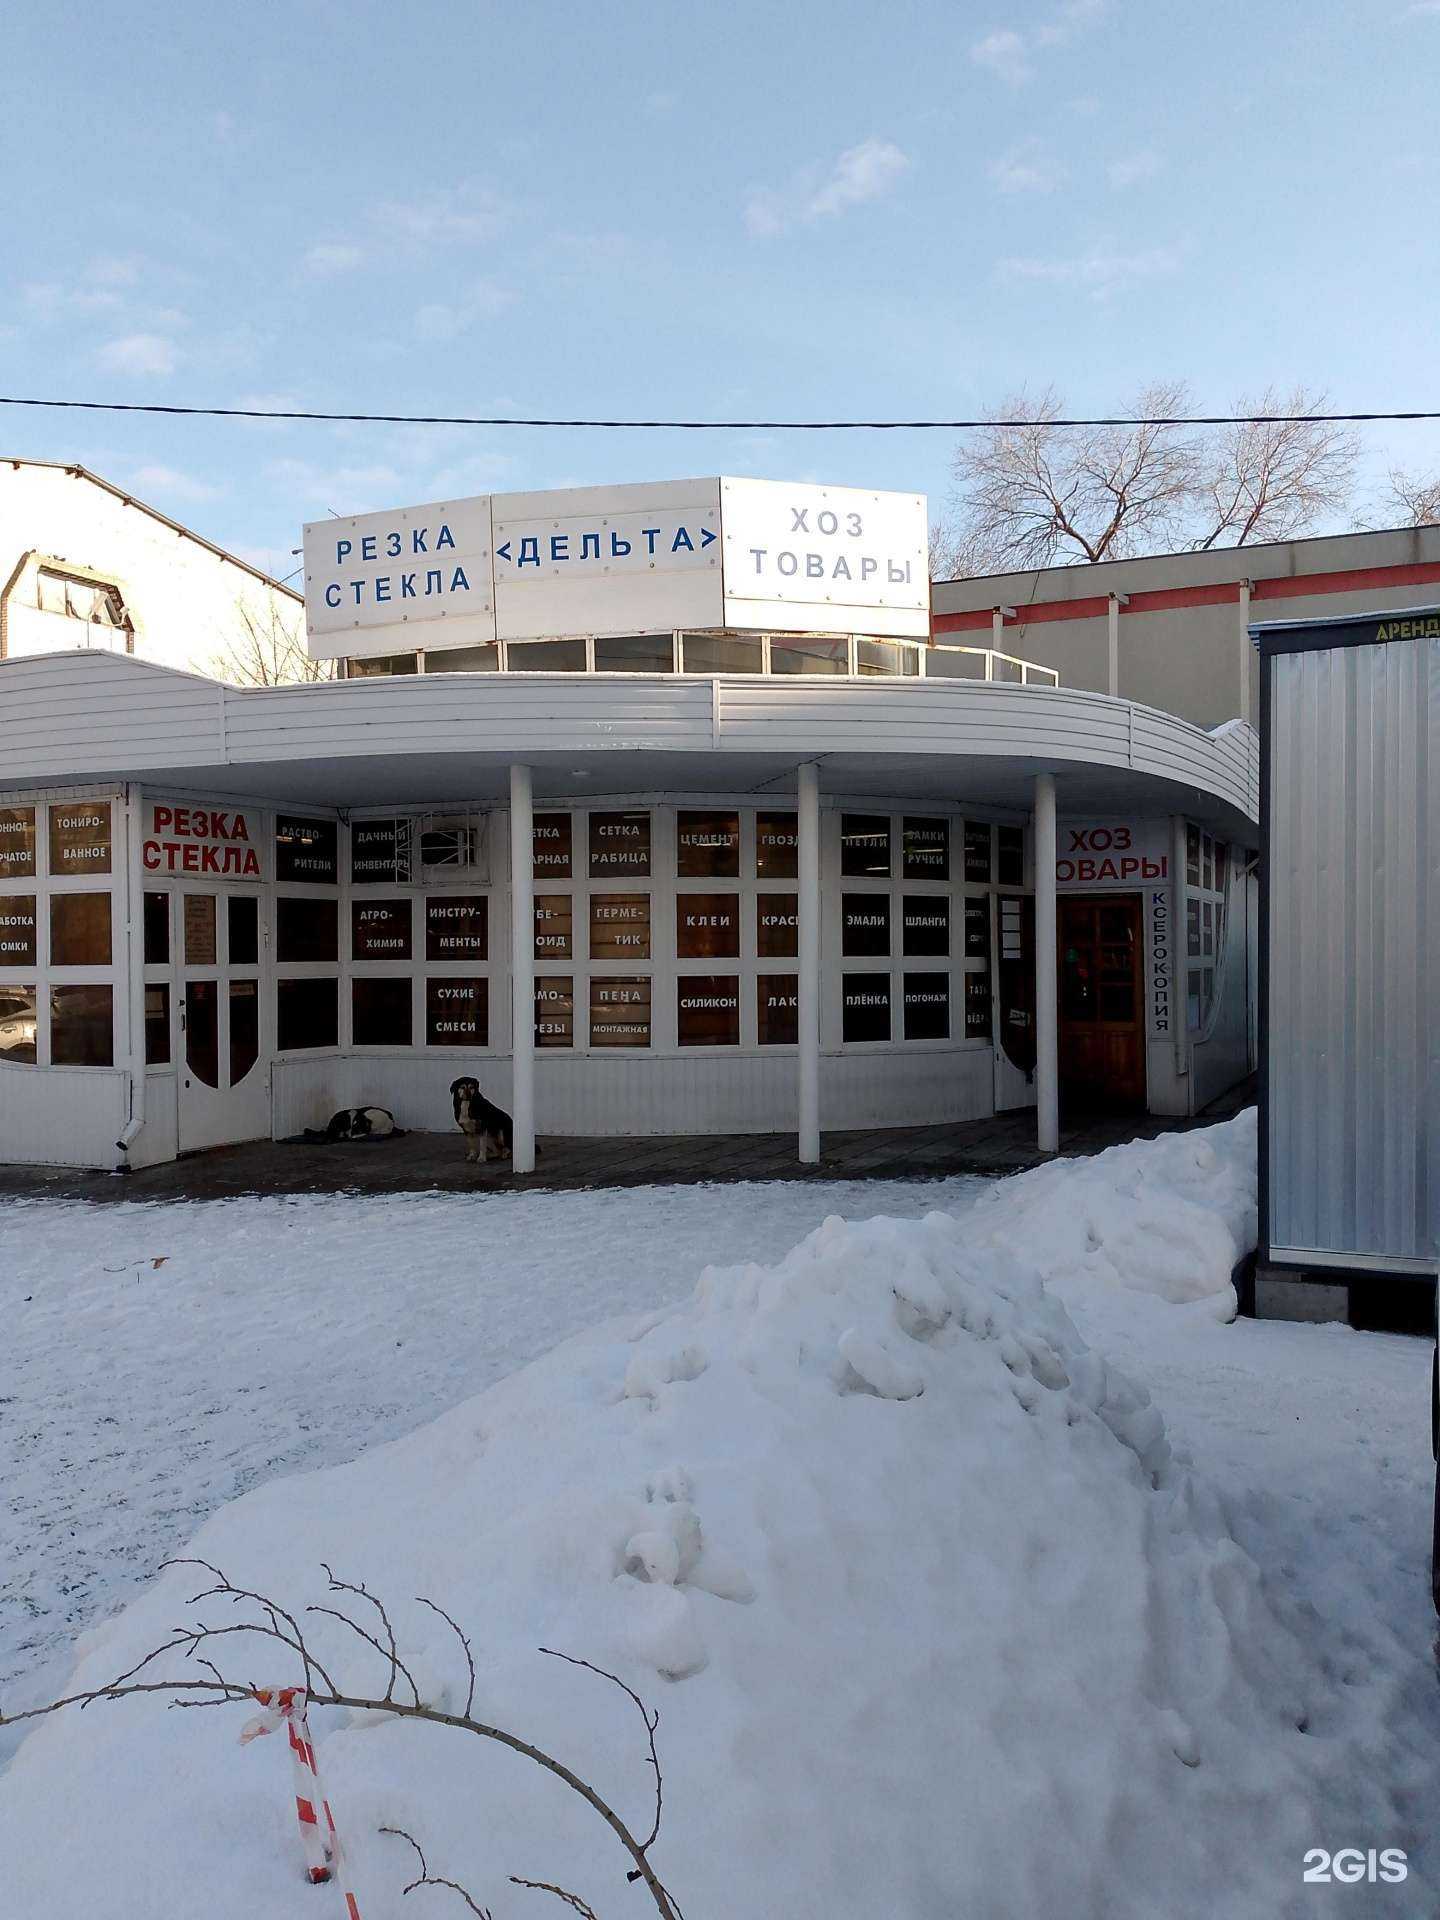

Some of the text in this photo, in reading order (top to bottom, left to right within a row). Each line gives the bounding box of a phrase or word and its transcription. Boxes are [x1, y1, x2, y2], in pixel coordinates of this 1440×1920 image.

[791, 507, 863, 538] ХОЗ
[337, 524, 457, 564] РЕЗКА
[749, 548, 912, 584] ТОВАРЫ
[325, 566, 471, 609] СТЕКЛА
[57, 817, 104, 829] ТОНИРО-
[154, 806, 249, 841] РЕЗКА
[599, 825, 640, 836] СЕТКА
[680, 833, 736, 846] ЦЕМЕНТ
[1069, 828, 1132, 852] ХОЗ
[63, 847, 106, 859] ВАННОЕ
[143, 840, 261, 875] СТЕКЛА
[591, 852, 648, 864] РАБИЦА
[908, 854, 944, 865] РУЧКИ
[360, 909, 393, 920] АГРО-
[429, 908, 481, 919] ИНСТРУ-
[596, 908, 644, 919] ГЕРМЕ-
[686, 915, 730, 926] КЛЕИ
[847, 915, 885, 926] ЭМАЛИ
[905, 916, 947, 927] ШЛАНГИ
[366, 938, 404, 949] ХИМИЯ
[439, 937, 481, 948] МЕНТЫ
[614, 935, 641, 945] ТИК
[1152, 892, 1169, 1031] КСЕРОКОПИЯ
[437, 988, 475, 999] СУХИЕ
[600, 990, 641, 1001] ПЕНА
[905, 993, 948, 1004] ПОГОНАЖ
[680, 998, 737, 1008] СИЛИКОН
[846, 994, 889, 1006] ПЛЁНКА
[436, 1022, 477, 1032] СМЕСИ
[592, 1025, 648, 1034] МОНТАЖНАЯ
